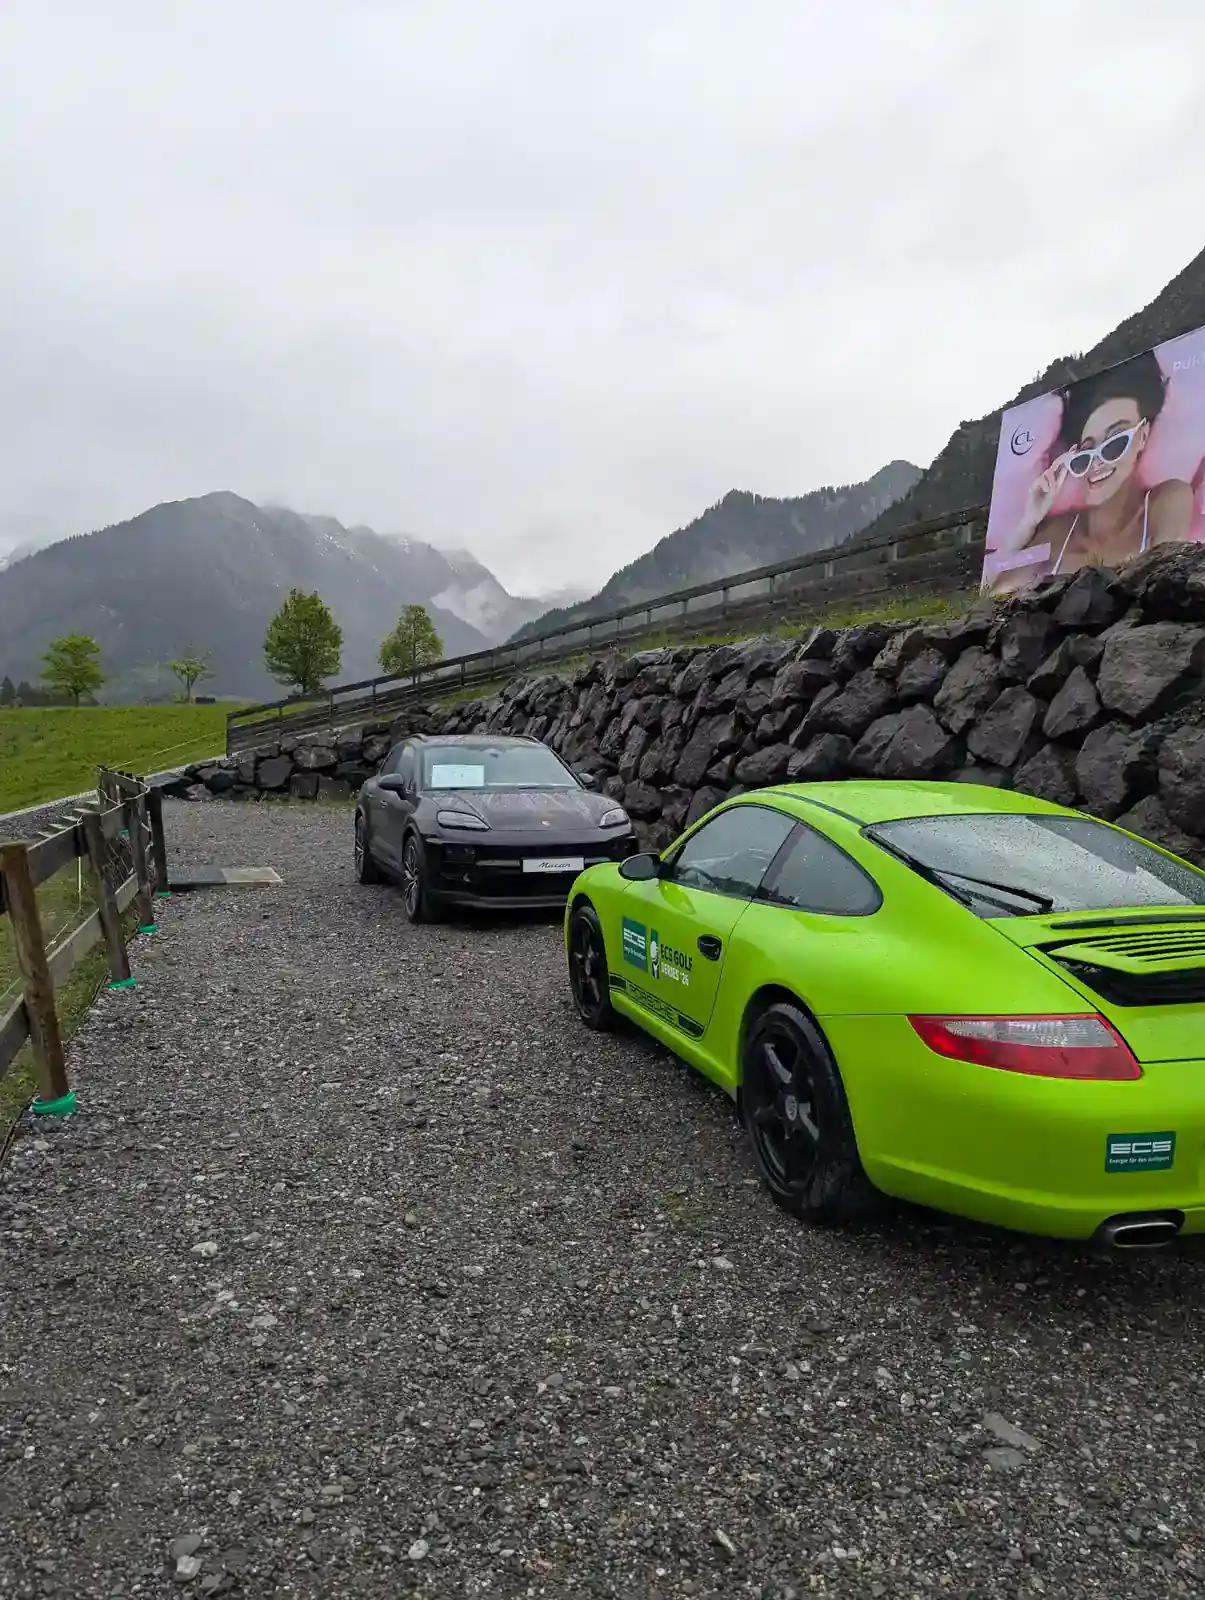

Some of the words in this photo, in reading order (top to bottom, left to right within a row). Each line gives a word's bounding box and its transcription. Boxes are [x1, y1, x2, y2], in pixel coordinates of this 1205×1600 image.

[538, 861, 571, 869] Macan
[623, 927, 646, 950] ECS
[660, 943, 673, 962] ECS
[673, 950, 693, 972] GOLF
[1110, 1140, 1172, 1154] ECS
